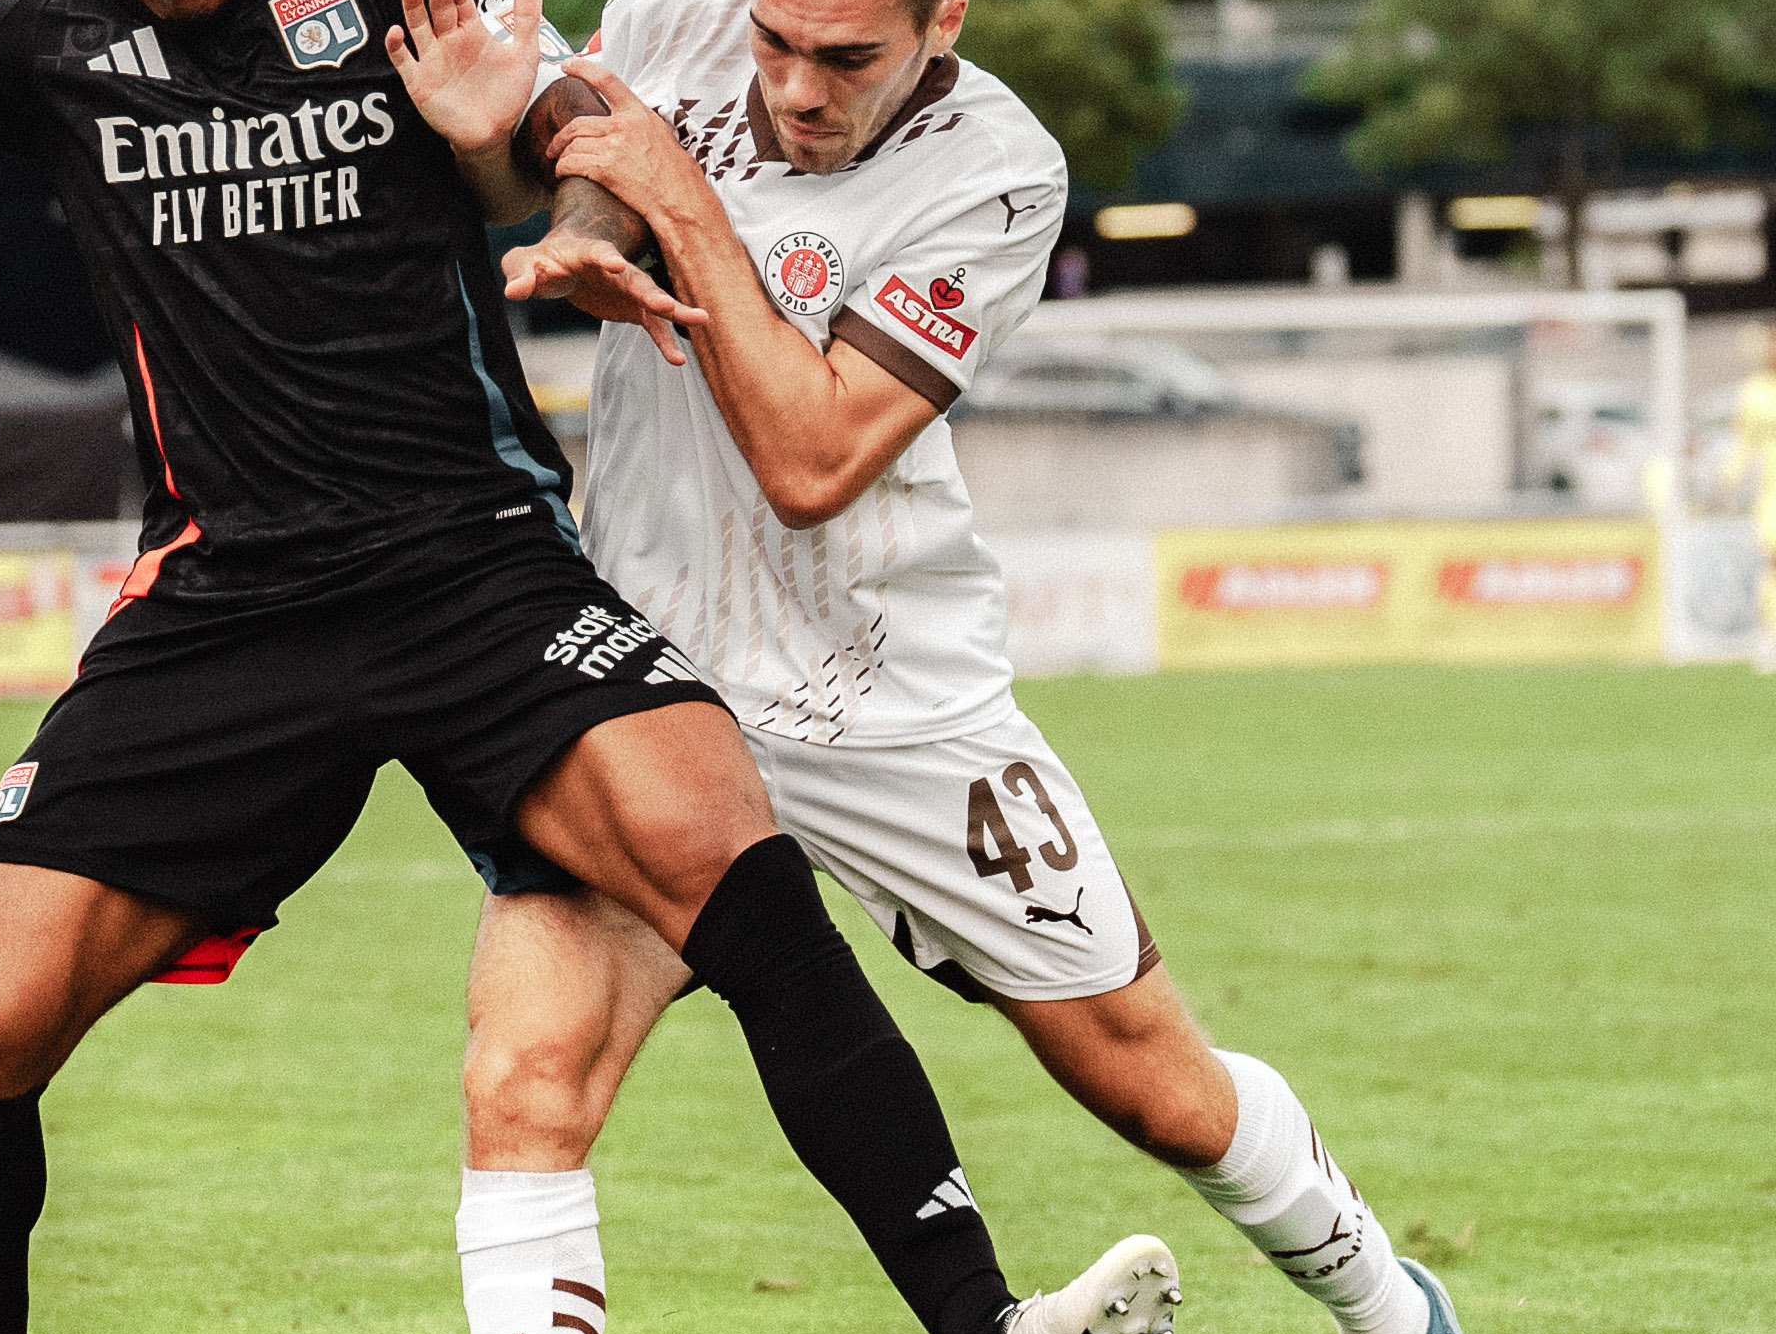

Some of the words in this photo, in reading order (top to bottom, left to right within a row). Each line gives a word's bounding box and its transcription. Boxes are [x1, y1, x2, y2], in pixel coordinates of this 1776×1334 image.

[295, 8, 359, 56] OL
[95, 92, 396, 184] Emirates
[152, 186, 207, 246] FLY
[221, 165, 362, 238] BETTER
[773, 243, 790, 260] FC
[793, 235, 812, 248] ST.
[816, 240, 841, 287] PAULI
[778, 291, 808, 312] 1910
[884, 288, 965, 351] ASTRA
[966, 761, 1079, 895] 43
